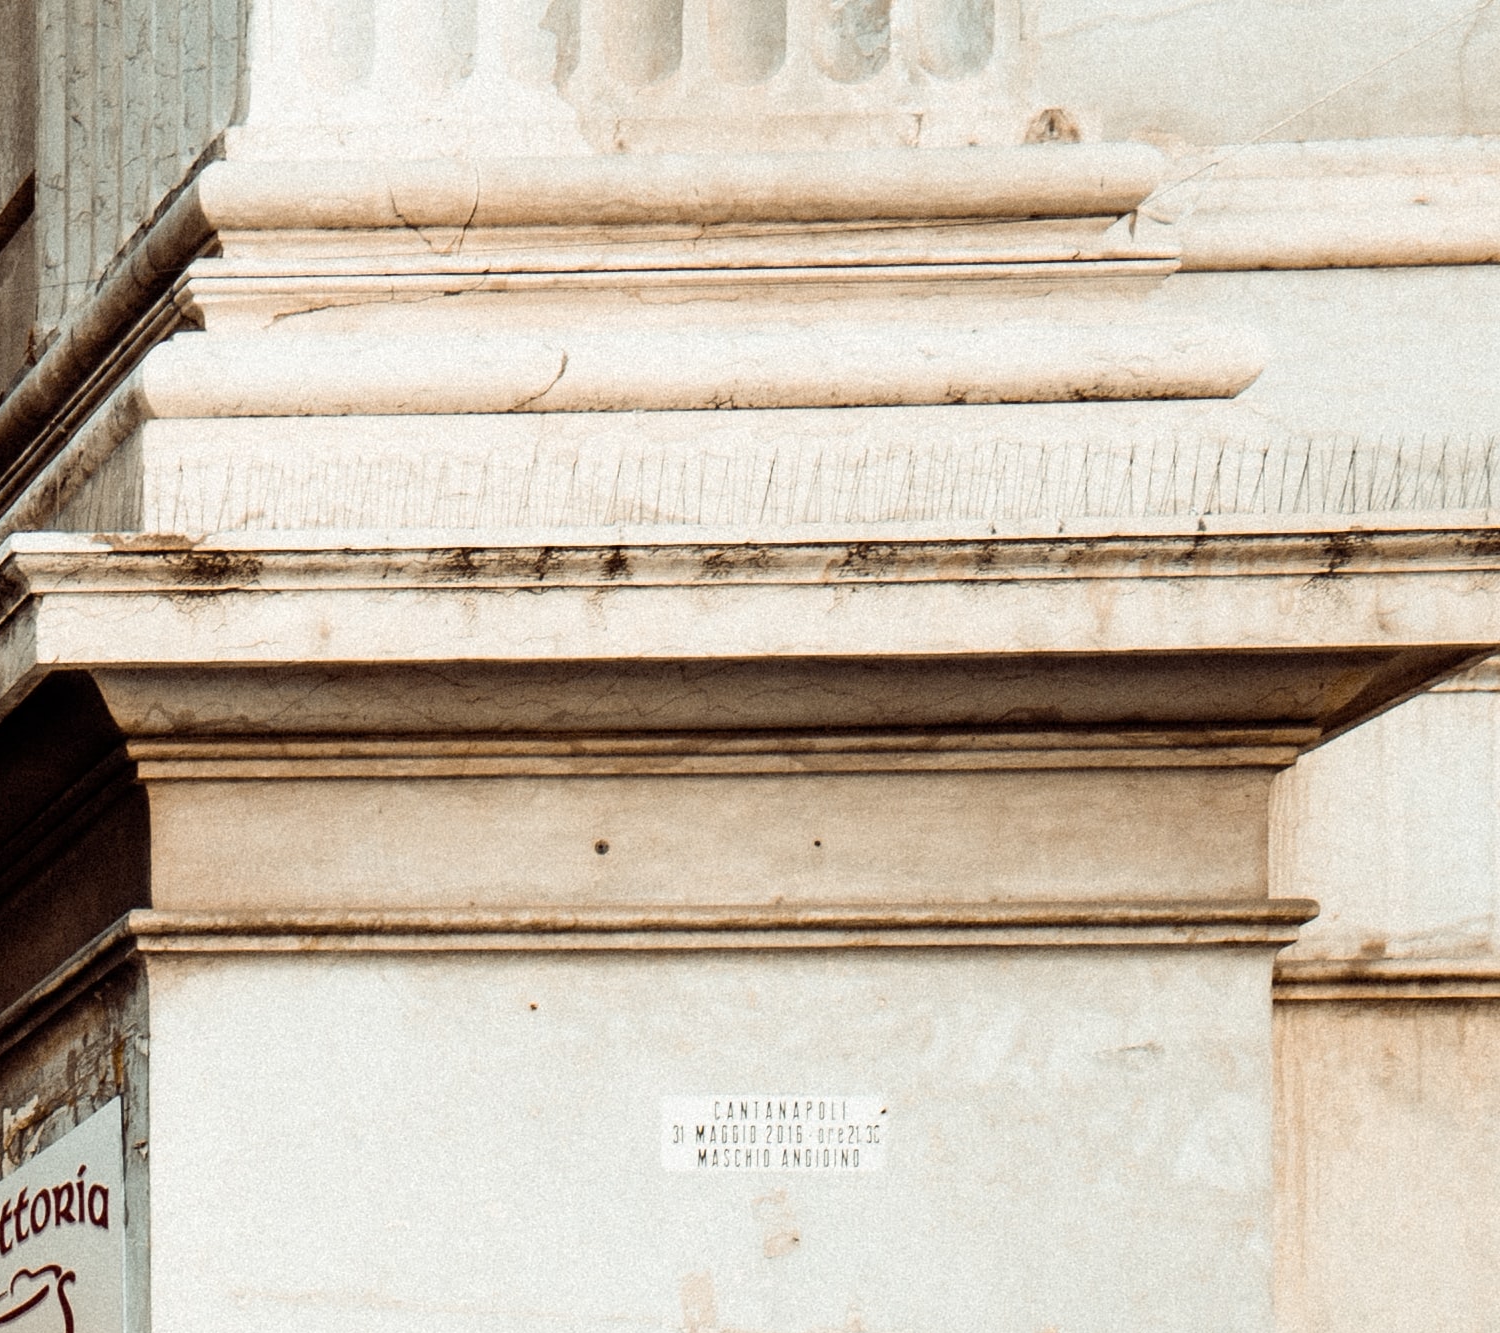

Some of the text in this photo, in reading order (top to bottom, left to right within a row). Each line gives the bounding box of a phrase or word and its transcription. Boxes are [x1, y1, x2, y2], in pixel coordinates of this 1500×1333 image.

[714, 1101, 846, 1121] CANTANAPOLI
[672, 1125, 684, 1144] 31
[696, 1125, 757, 1144] MAGGIO
[766, 1125, 802, 1144] 2016
[698, 1149, 860, 1168] MASCHIO ANGIOINO
